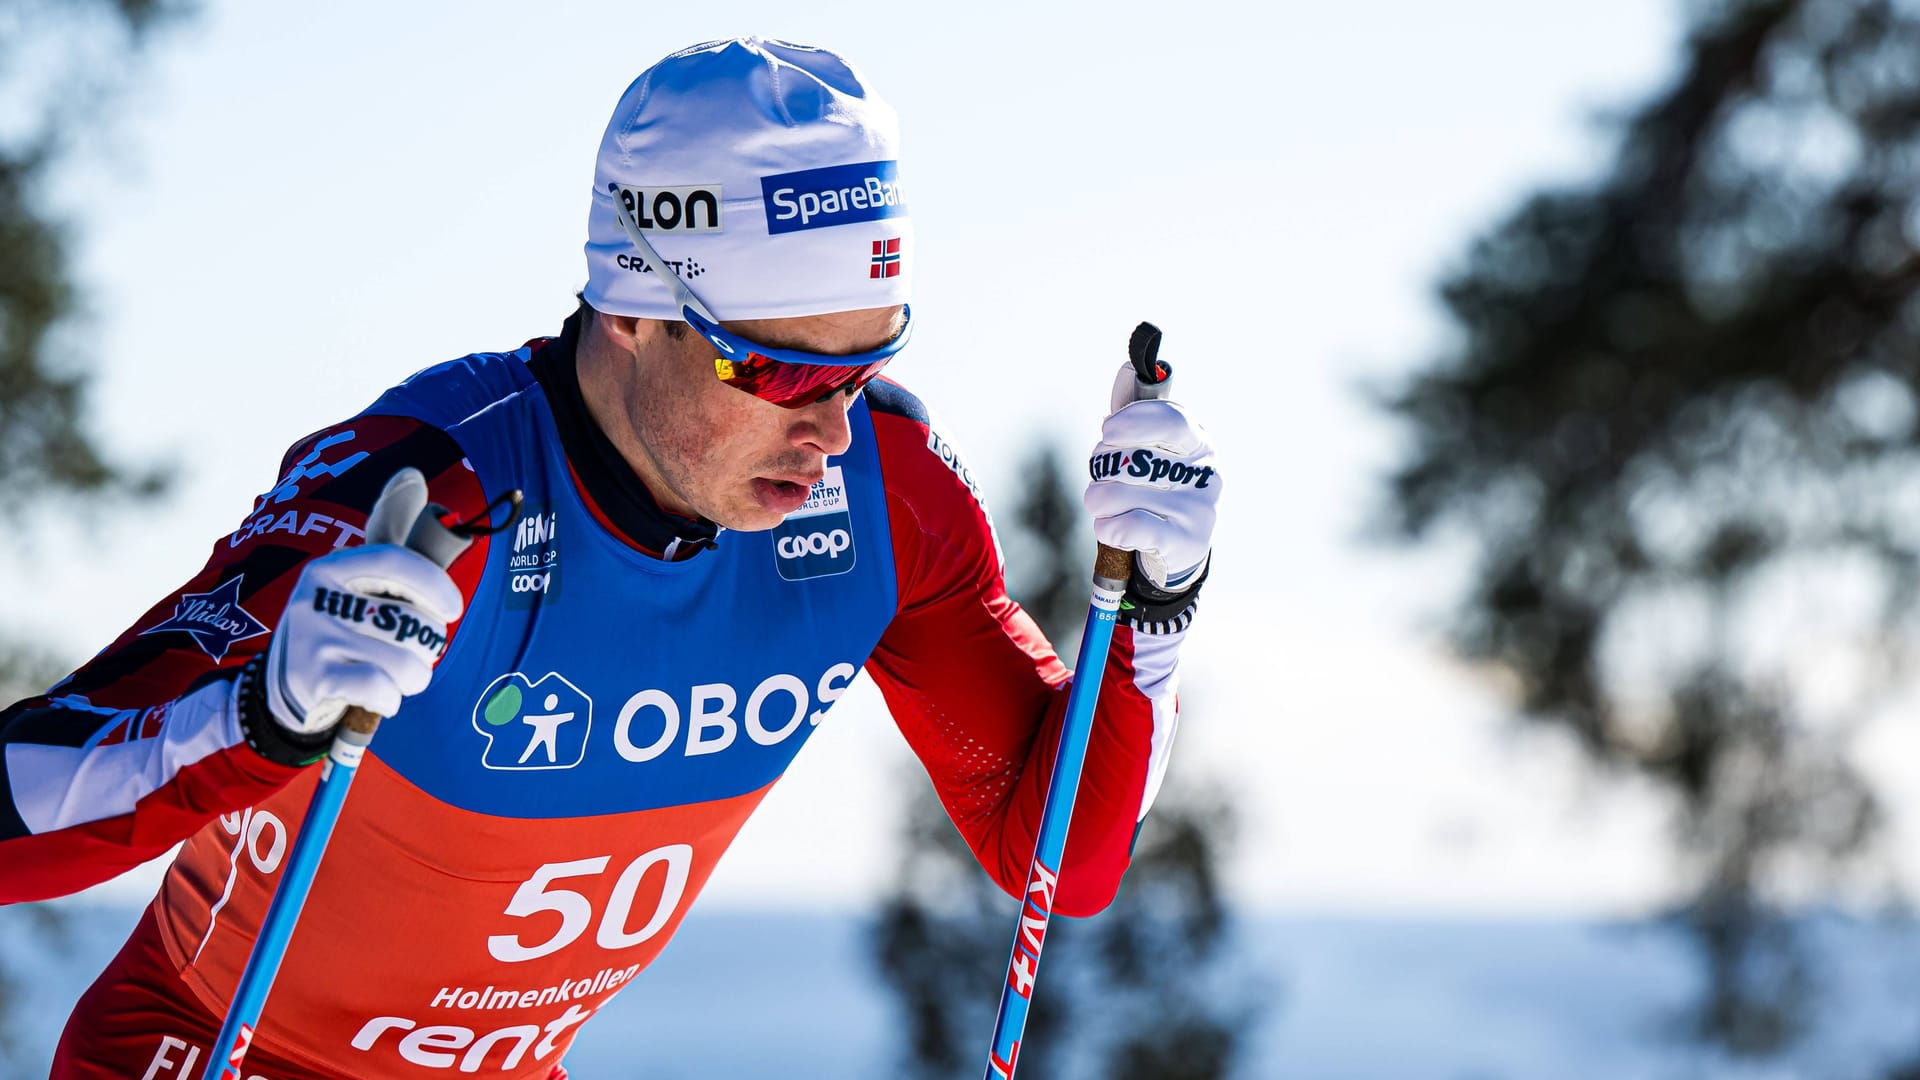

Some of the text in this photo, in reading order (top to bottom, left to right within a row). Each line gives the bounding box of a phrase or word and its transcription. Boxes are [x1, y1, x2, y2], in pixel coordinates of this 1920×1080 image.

[822, 497, 840, 507] CUP
[230, 510, 366, 548] CRAFT
[777, 529, 850, 559] coop
[176, 599, 248, 637] Nidar
[613, 662, 855, 763] OBOS
[487, 843, 694, 963] 50
[430, 963, 640, 1010] Holmenkollen
[350, 1003, 612, 1073] rent
